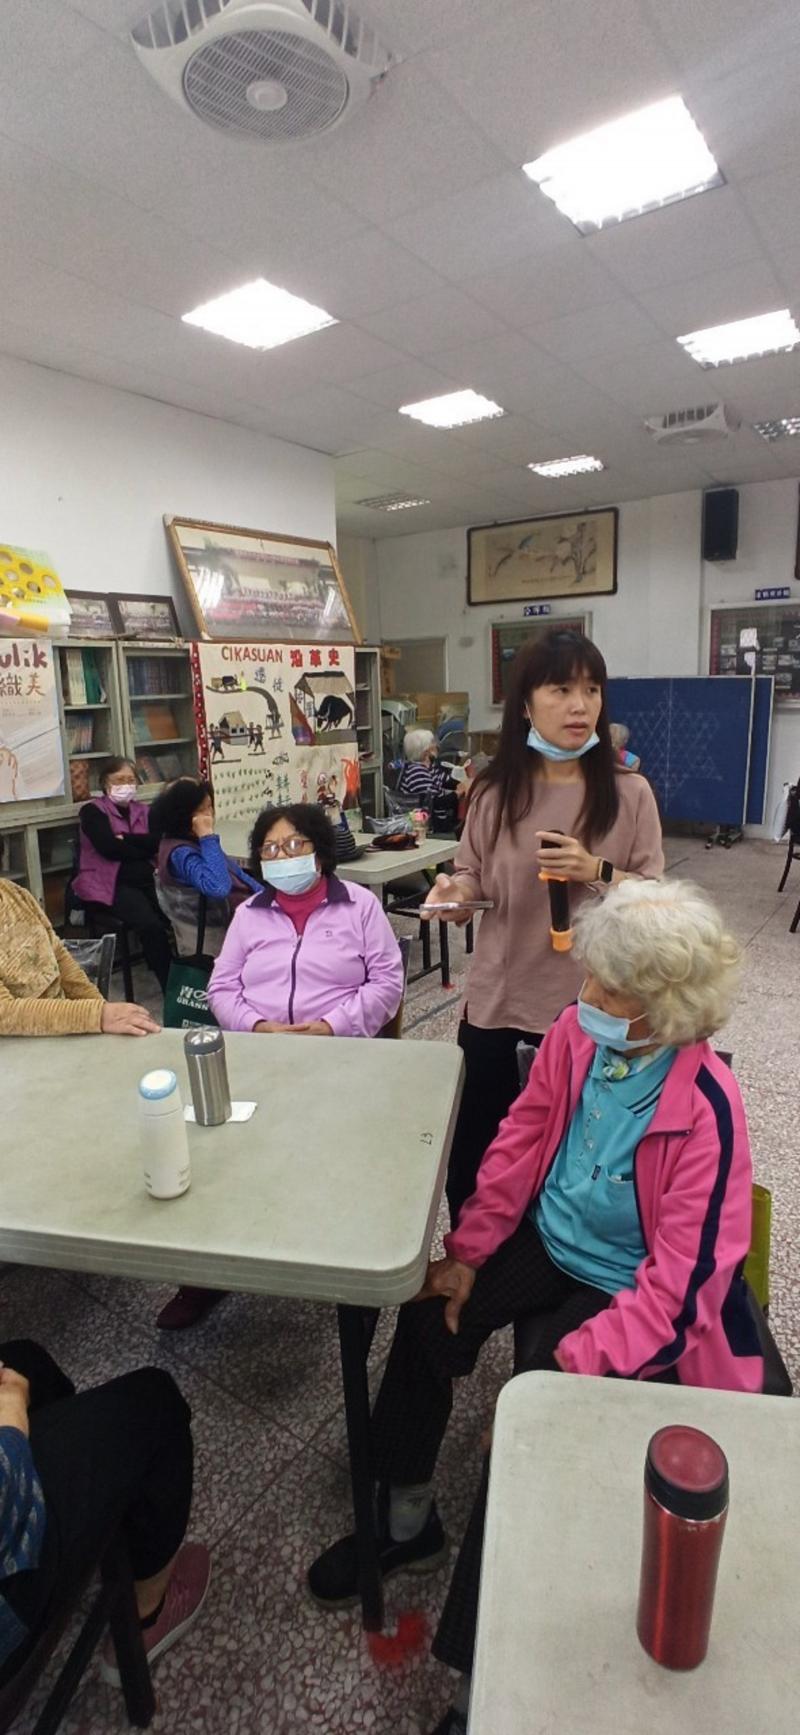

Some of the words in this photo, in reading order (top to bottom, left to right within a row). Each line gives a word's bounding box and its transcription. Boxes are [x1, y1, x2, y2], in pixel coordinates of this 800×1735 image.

[221, 645, 283, 664] CIKASUAN
[289, 647, 340, 668] 沿革史
